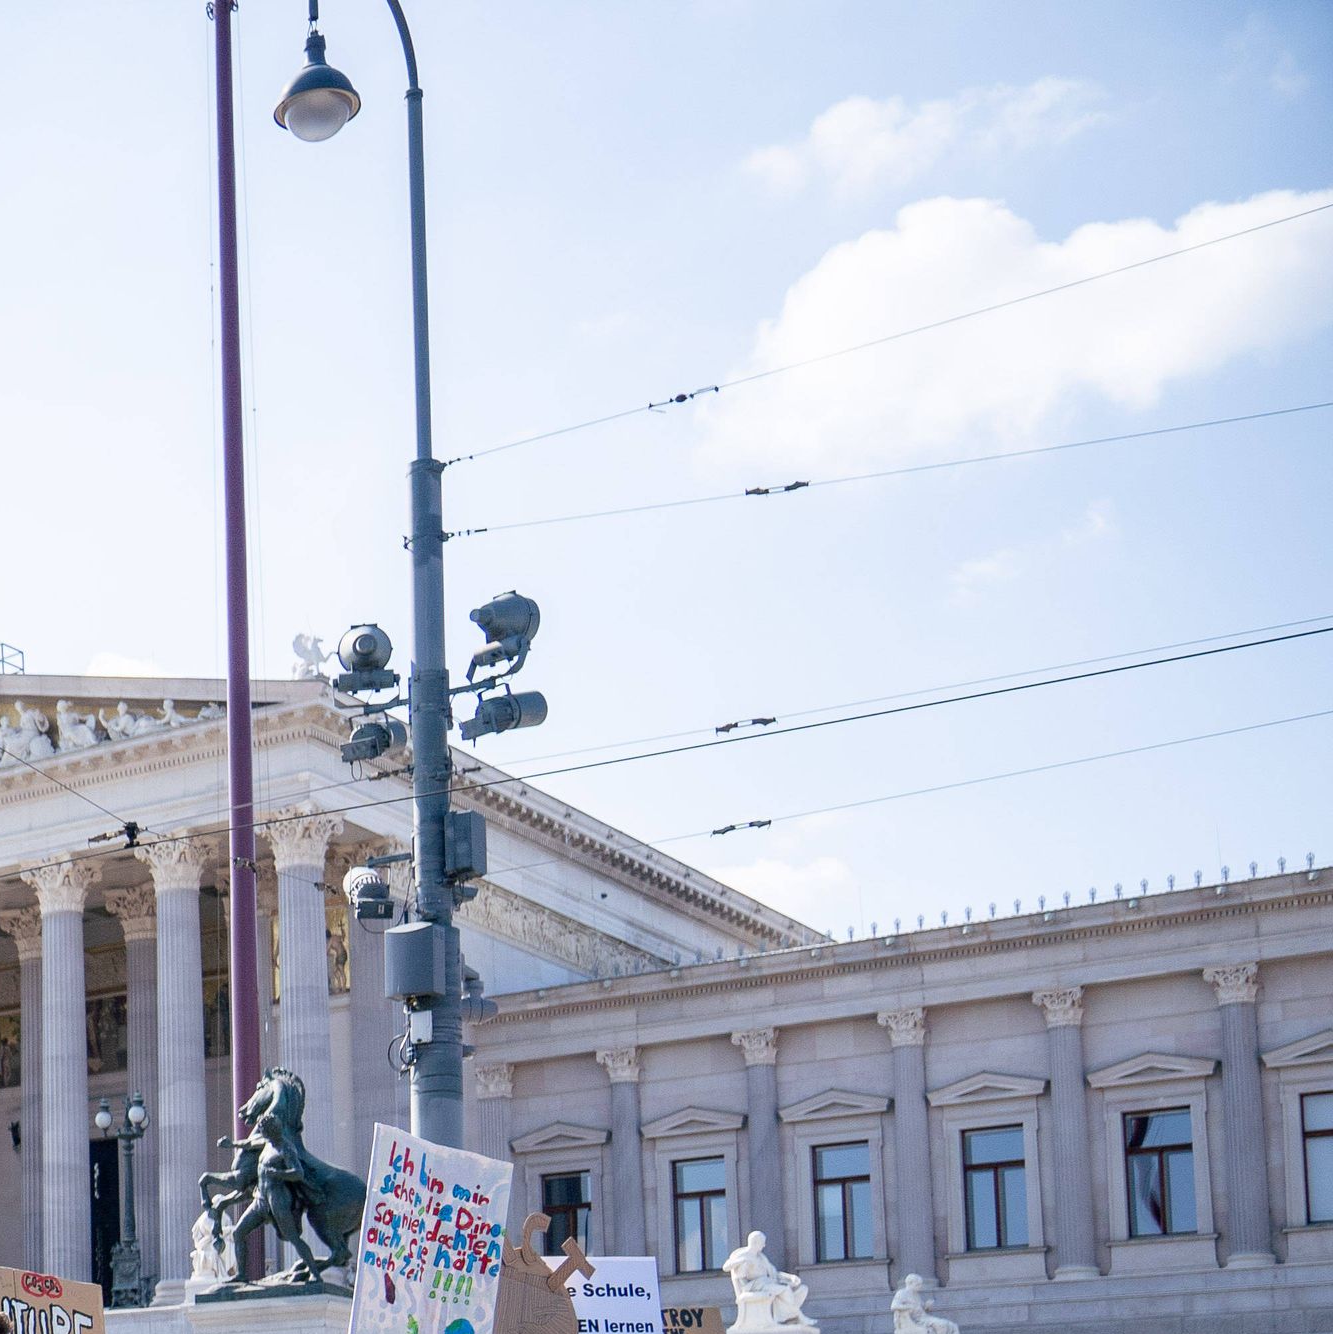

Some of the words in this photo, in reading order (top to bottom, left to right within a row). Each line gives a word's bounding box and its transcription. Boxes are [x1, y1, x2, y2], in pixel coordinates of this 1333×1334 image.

[388, 1141, 415, 1176] Ich
[419, 1153, 444, 1194] bin
[452, 1184, 490, 1206] mir
[425, 1196, 453, 1222] die
[425, 1220, 501, 1260] dachten
[363, 1250, 396, 1272] noch
[583, 1283, 651, 1301] Schule,
[605, 1319, 654, 1334] lernen
